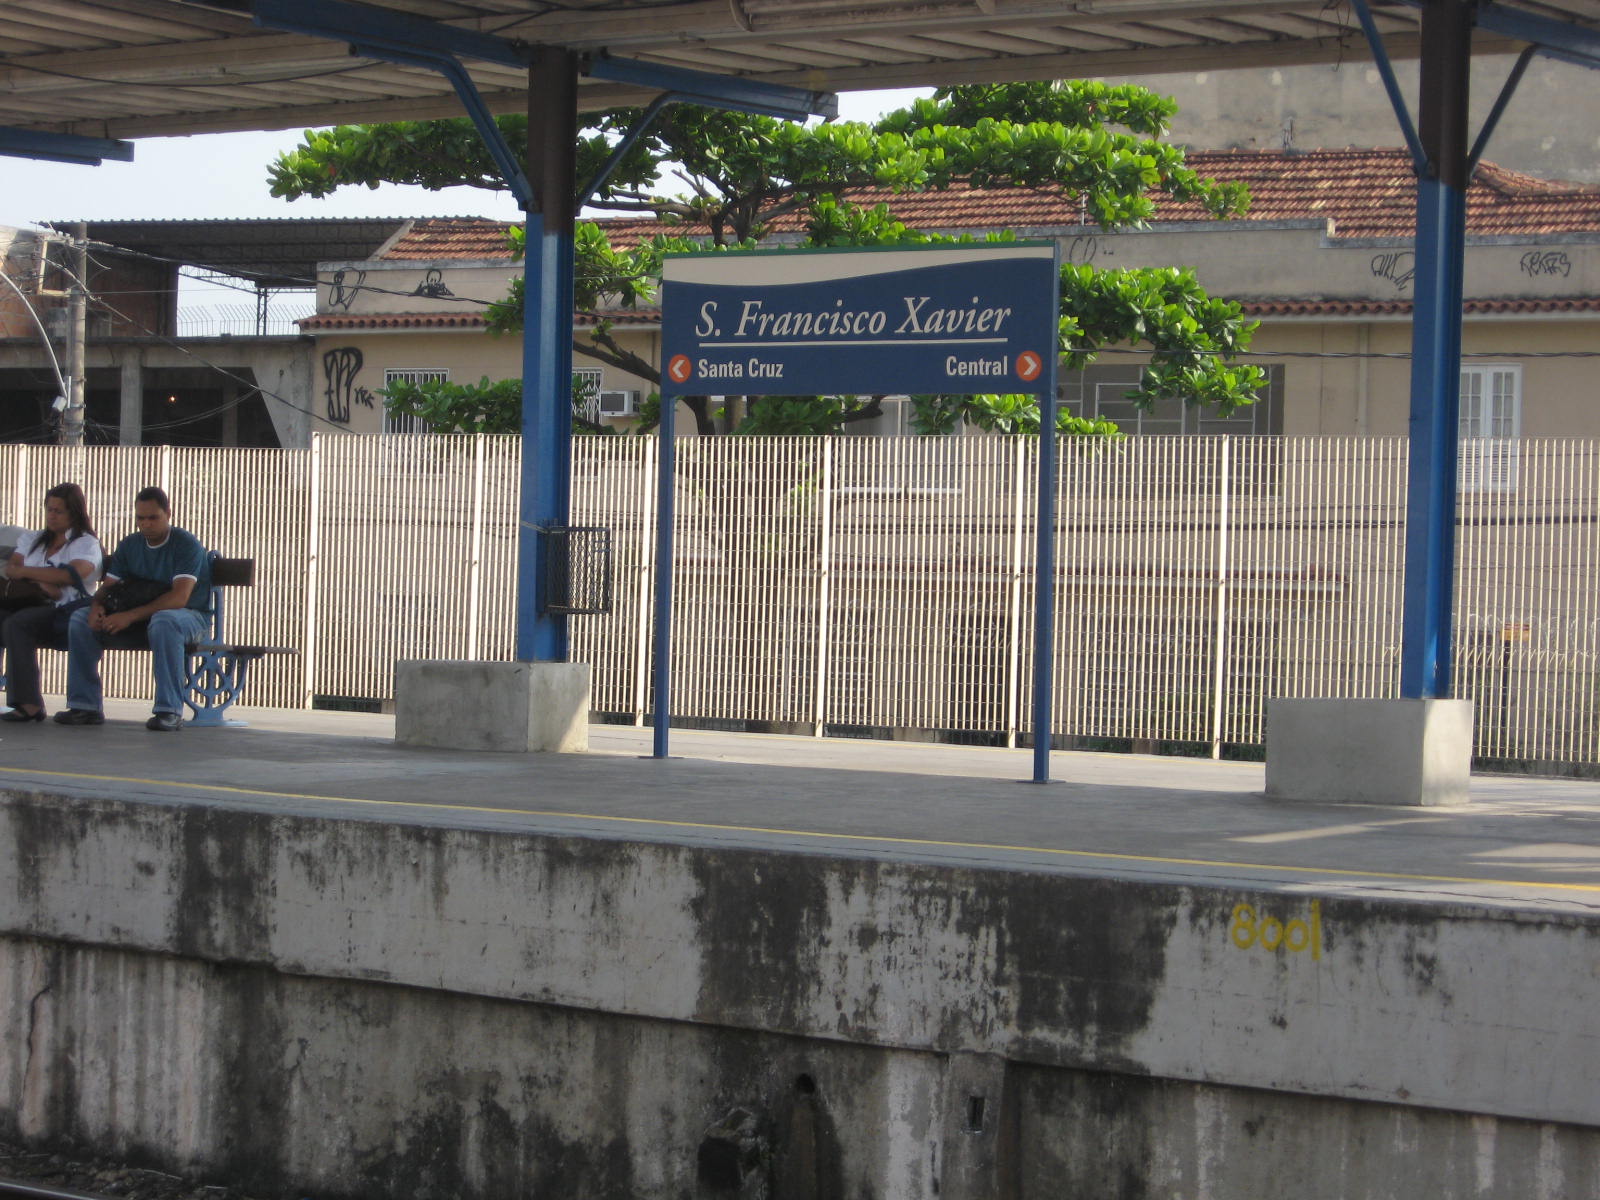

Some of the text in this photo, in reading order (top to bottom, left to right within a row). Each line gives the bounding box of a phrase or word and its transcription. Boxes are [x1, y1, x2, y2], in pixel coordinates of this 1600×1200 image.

[695, 296, 1012, 337] S. Francisco Xavier
[698, 358, 783, 378] Santa Cruz
[946, 355, 1008, 376] Central
